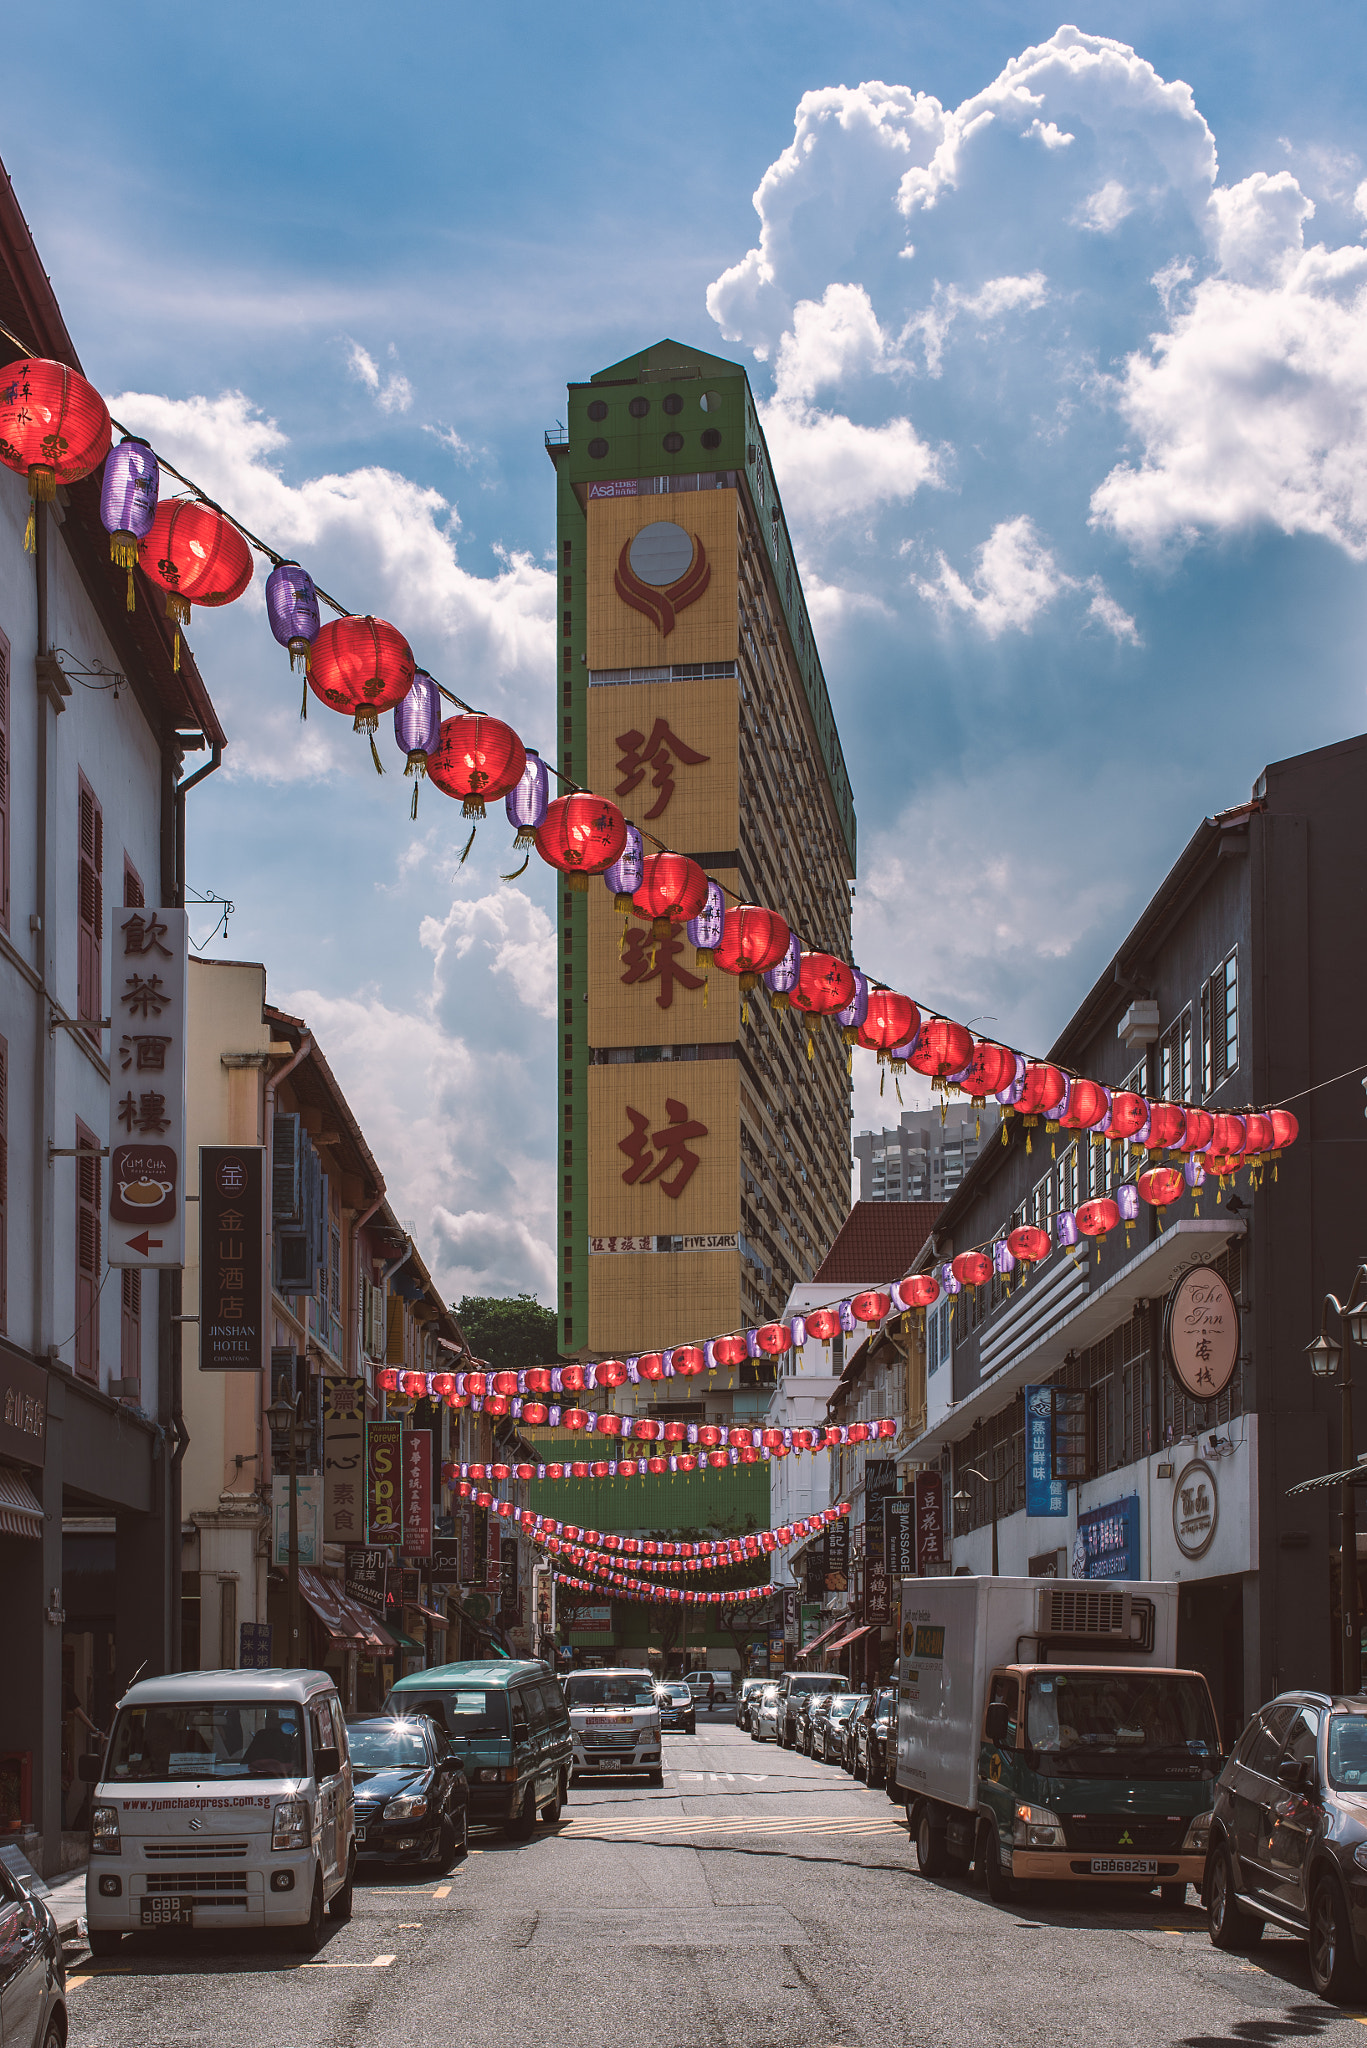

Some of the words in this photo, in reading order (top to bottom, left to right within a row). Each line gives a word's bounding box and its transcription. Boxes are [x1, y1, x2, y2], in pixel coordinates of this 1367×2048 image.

[590, 485, 615, 498] Asa
[119, 911, 174, 1133] 飲茶酒樓
[121, 1151, 144, 1178] YUM
[147, 1159, 167, 1174] CHA
[685, 1237, 706, 1249] FIVE
[707, 1235, 736, 1247] STARS
[217, 1208, 245, 1319] 金山酒店
[1185, 1284, 1222, 1304] The
[1184, 1306, 1224, 1326] Inn
[208, 1326, 256, 1337] JINSHAN
[213, 1340, 251, 1352] HOTEL
[1194, 1338, 1216, 1388] 客栈
[369, 1432, 400, 1444] Forever
[326, 1432, 361, 1470] 一心
[1032, 1421, 1046, 1480] 蒸出鲜味
[374, 1448, 395, 1526] Spa
[332, 1482, 356, 1531] 素食
[920, 1492, 941, 1553] 豆花庄
[900, 1515, 911, 1573] MASSAGE
[348, 1550, 385, 1569] 有机
[345, 1579, 384, 1600] ORGANIC
[293, 1628, 299, 1638] 9
[1345, 1611, 1352, 1637] 10
[123, 1796, 270, 1811] www.yumchaexpress.com.sg
[152, 1898, 180, 1911] GBB
[142, 1909, 192, 1924] 9894T
